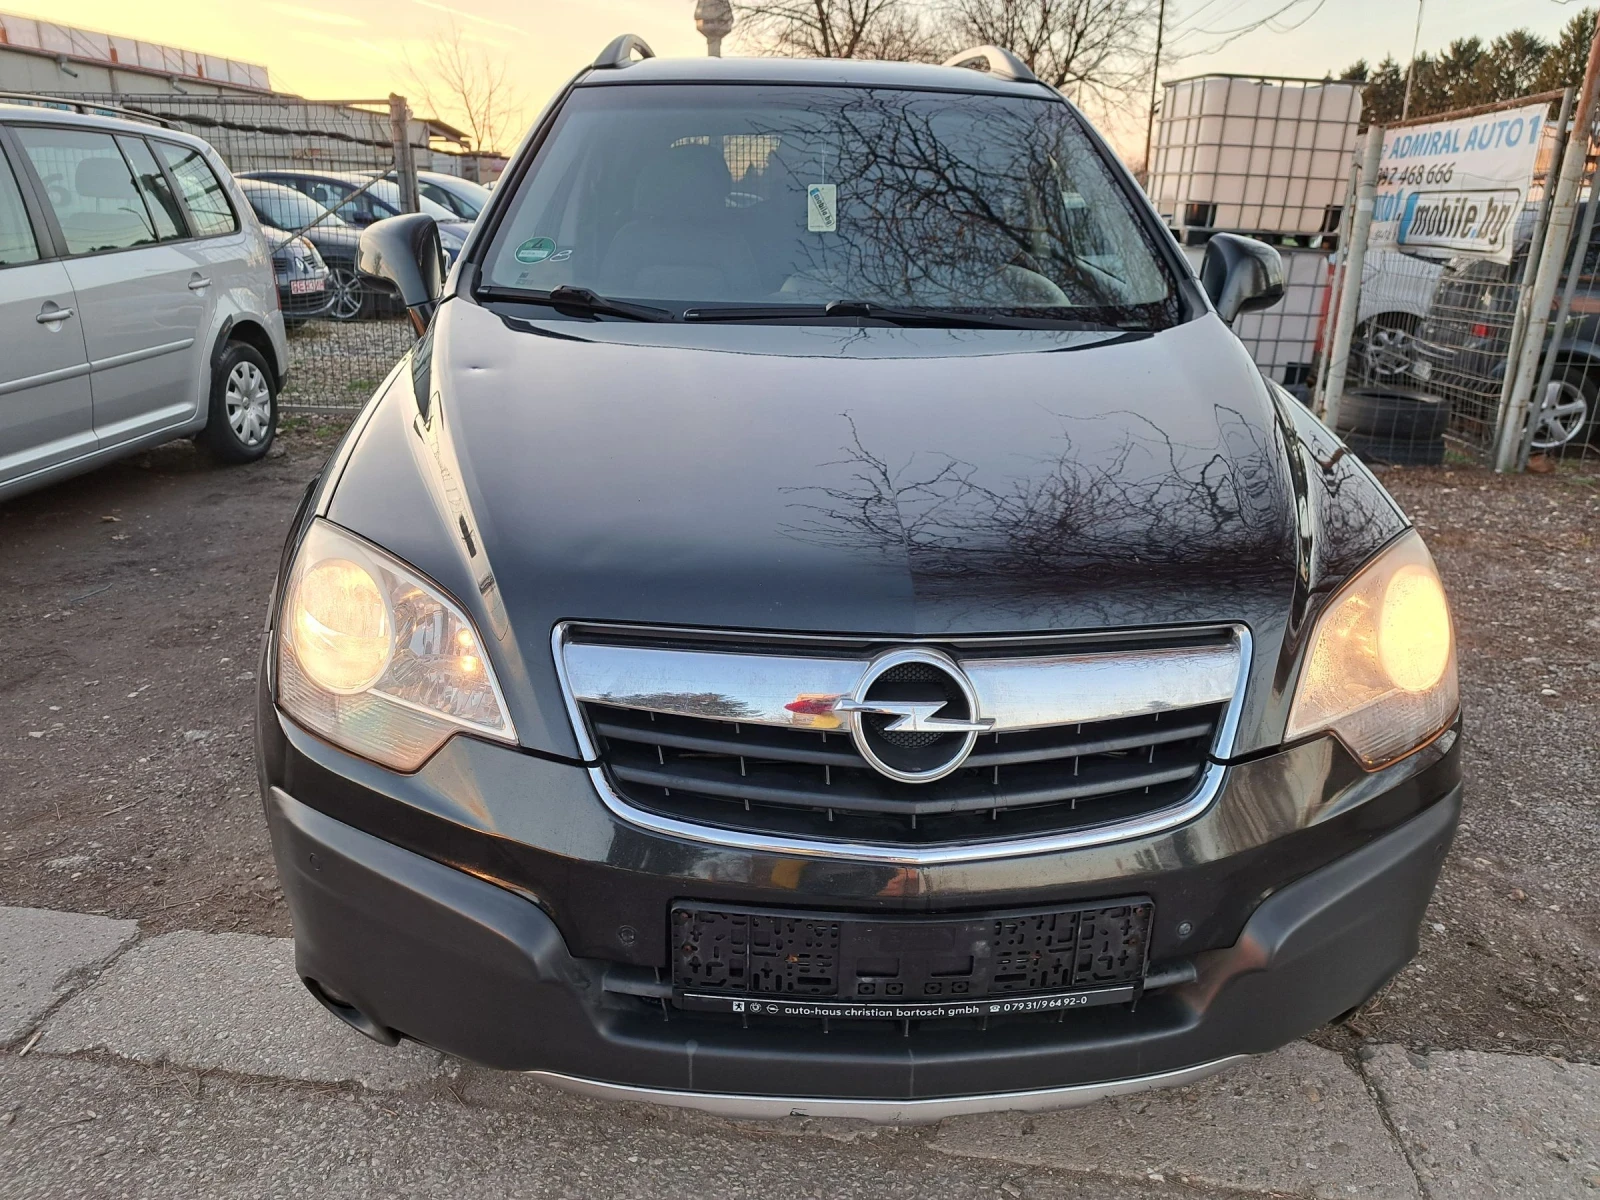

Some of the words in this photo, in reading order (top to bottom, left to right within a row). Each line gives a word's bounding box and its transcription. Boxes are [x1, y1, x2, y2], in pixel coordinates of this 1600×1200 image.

[1388, 128, 1460, 159] ADMIRAL
[1463, 118, 1523, 151] AUTO
[1528, 115, 1541, 144] 1
[1398, 164, 1425, 185] 468
[1426, 162, 1456, 183] 666
[1409, 197, 1511, 245] mobile.bg
[784, 1006, 842, 1017] auto-haus
[844, 1007, 893, 1017] christian
[896, 1007, 945, 1017] bartosch
[948, 1005, 980, 1017] gmbh
